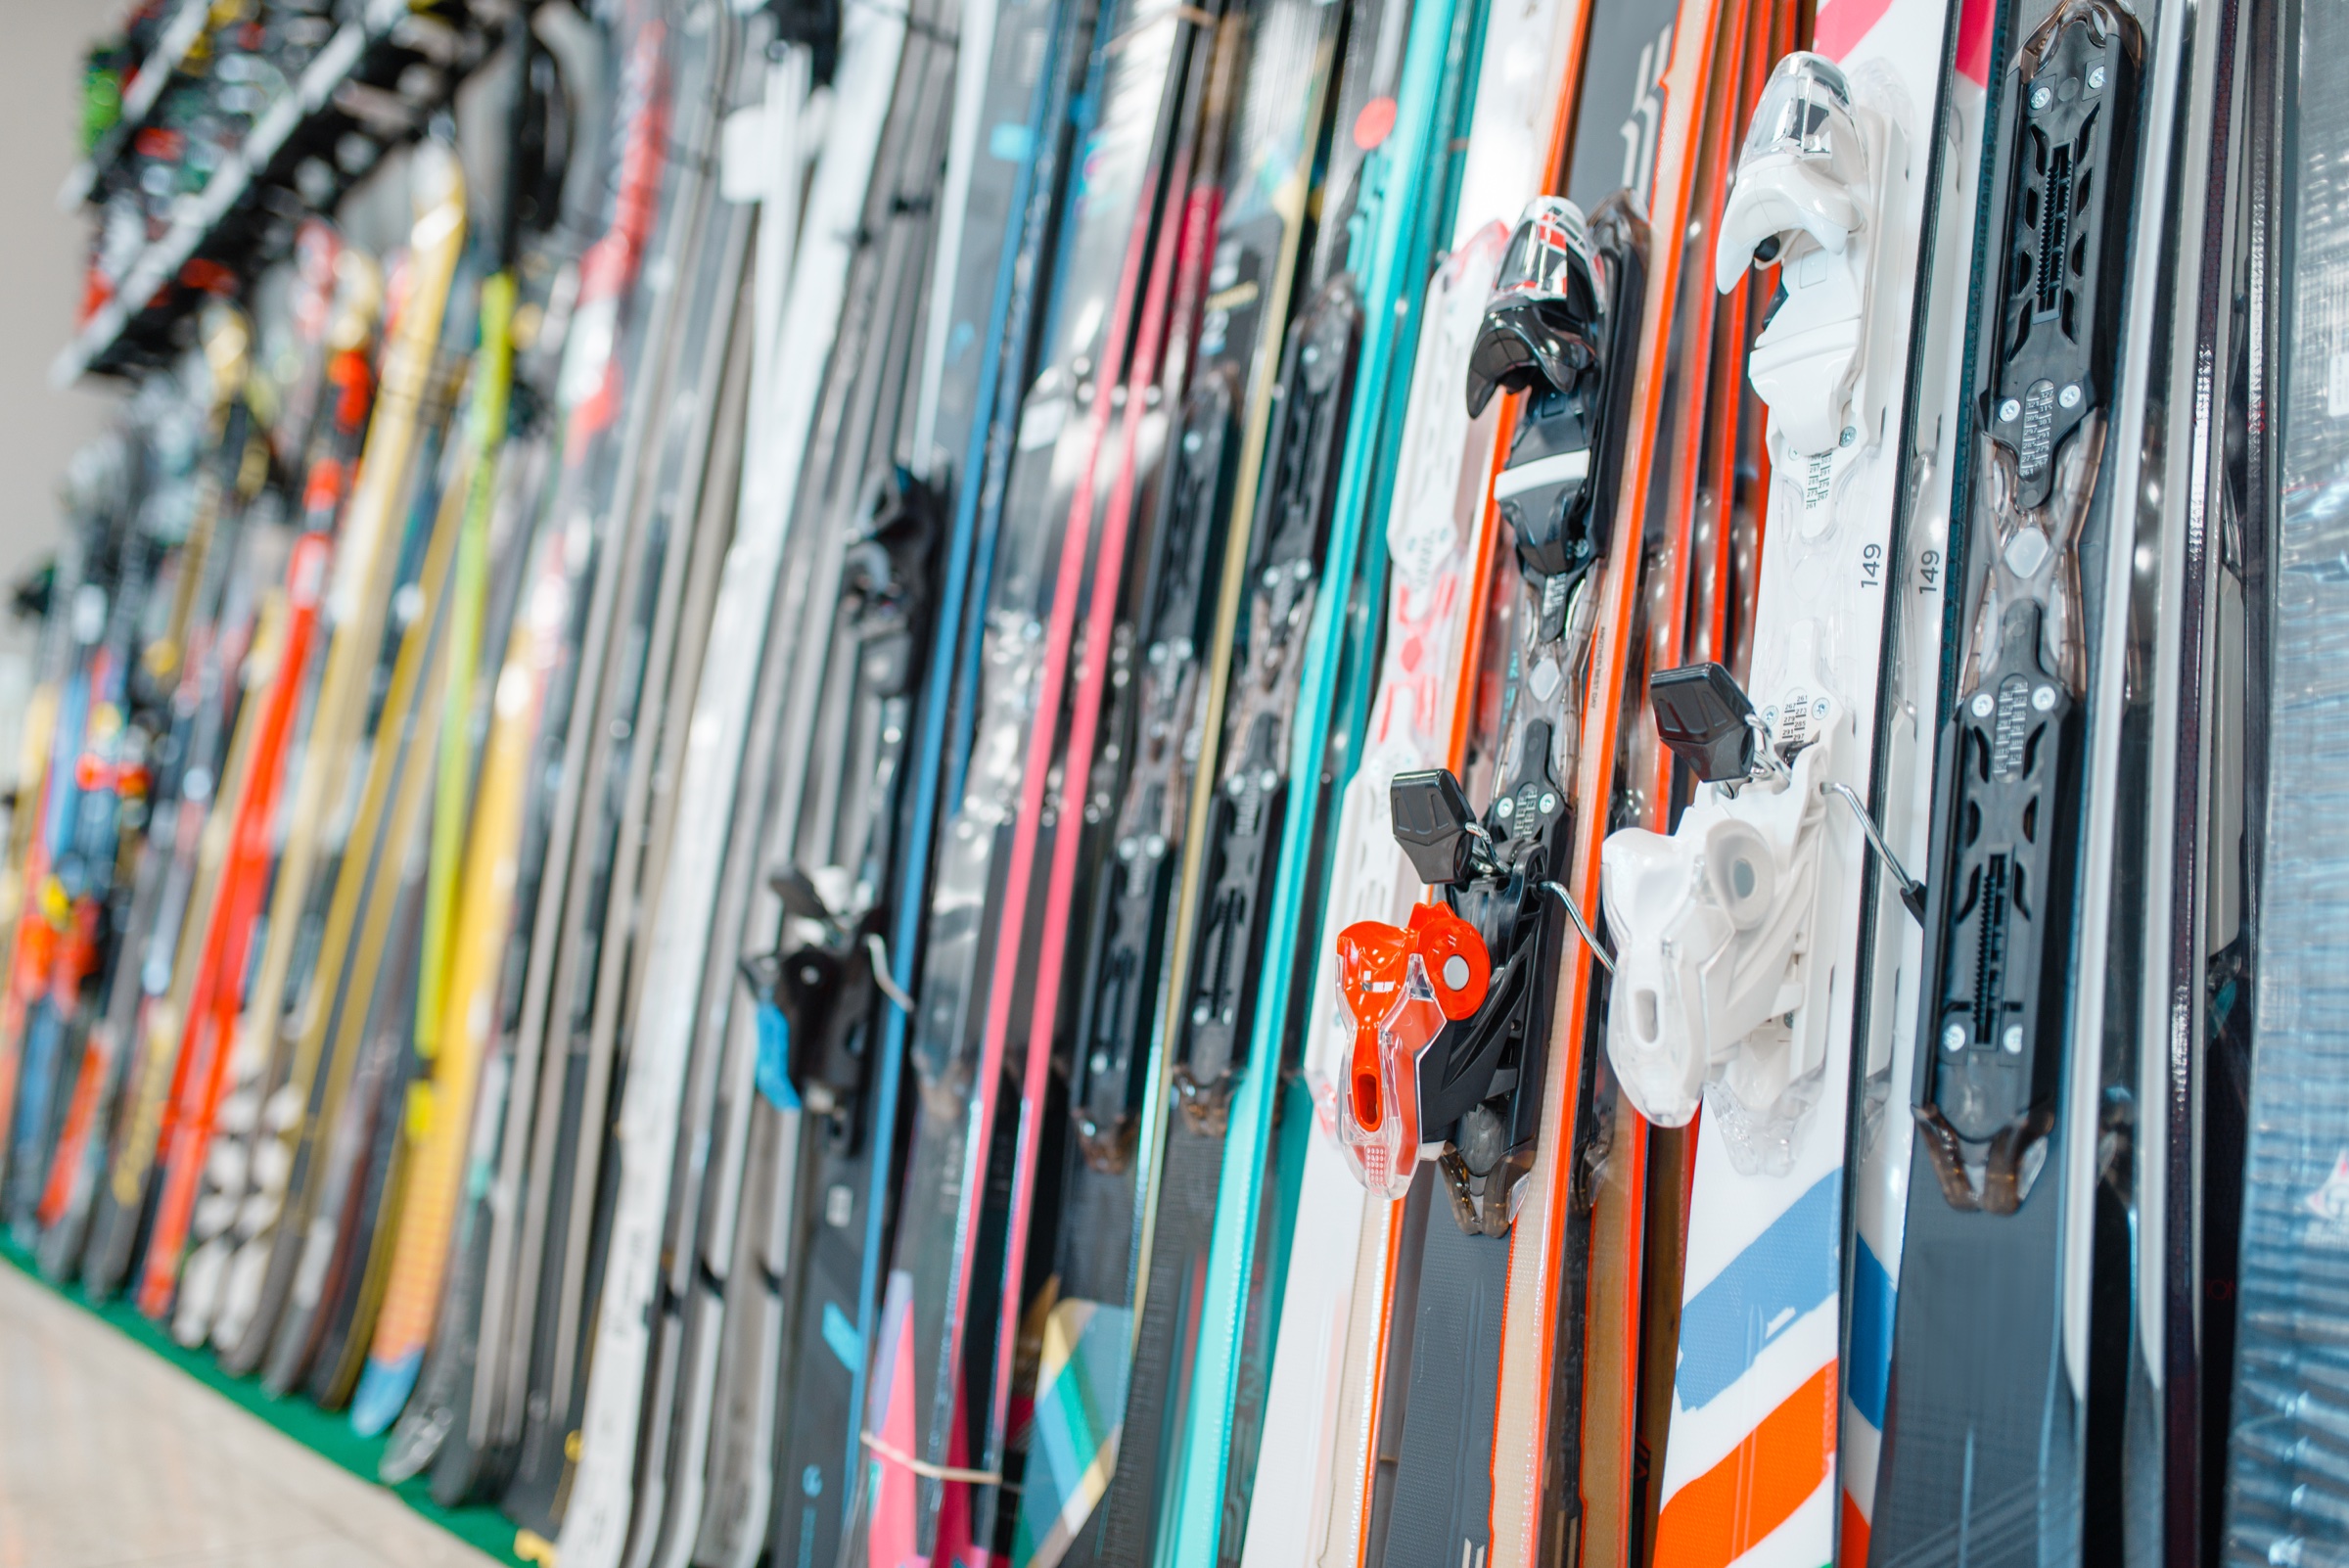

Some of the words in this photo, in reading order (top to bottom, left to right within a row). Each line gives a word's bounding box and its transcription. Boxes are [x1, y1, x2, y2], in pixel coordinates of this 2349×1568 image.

[1861, 543, 1881, 588] 149
[1918, 550, 1940, 594] 149
[1595, 626, 1605, 667] ANOTHER
